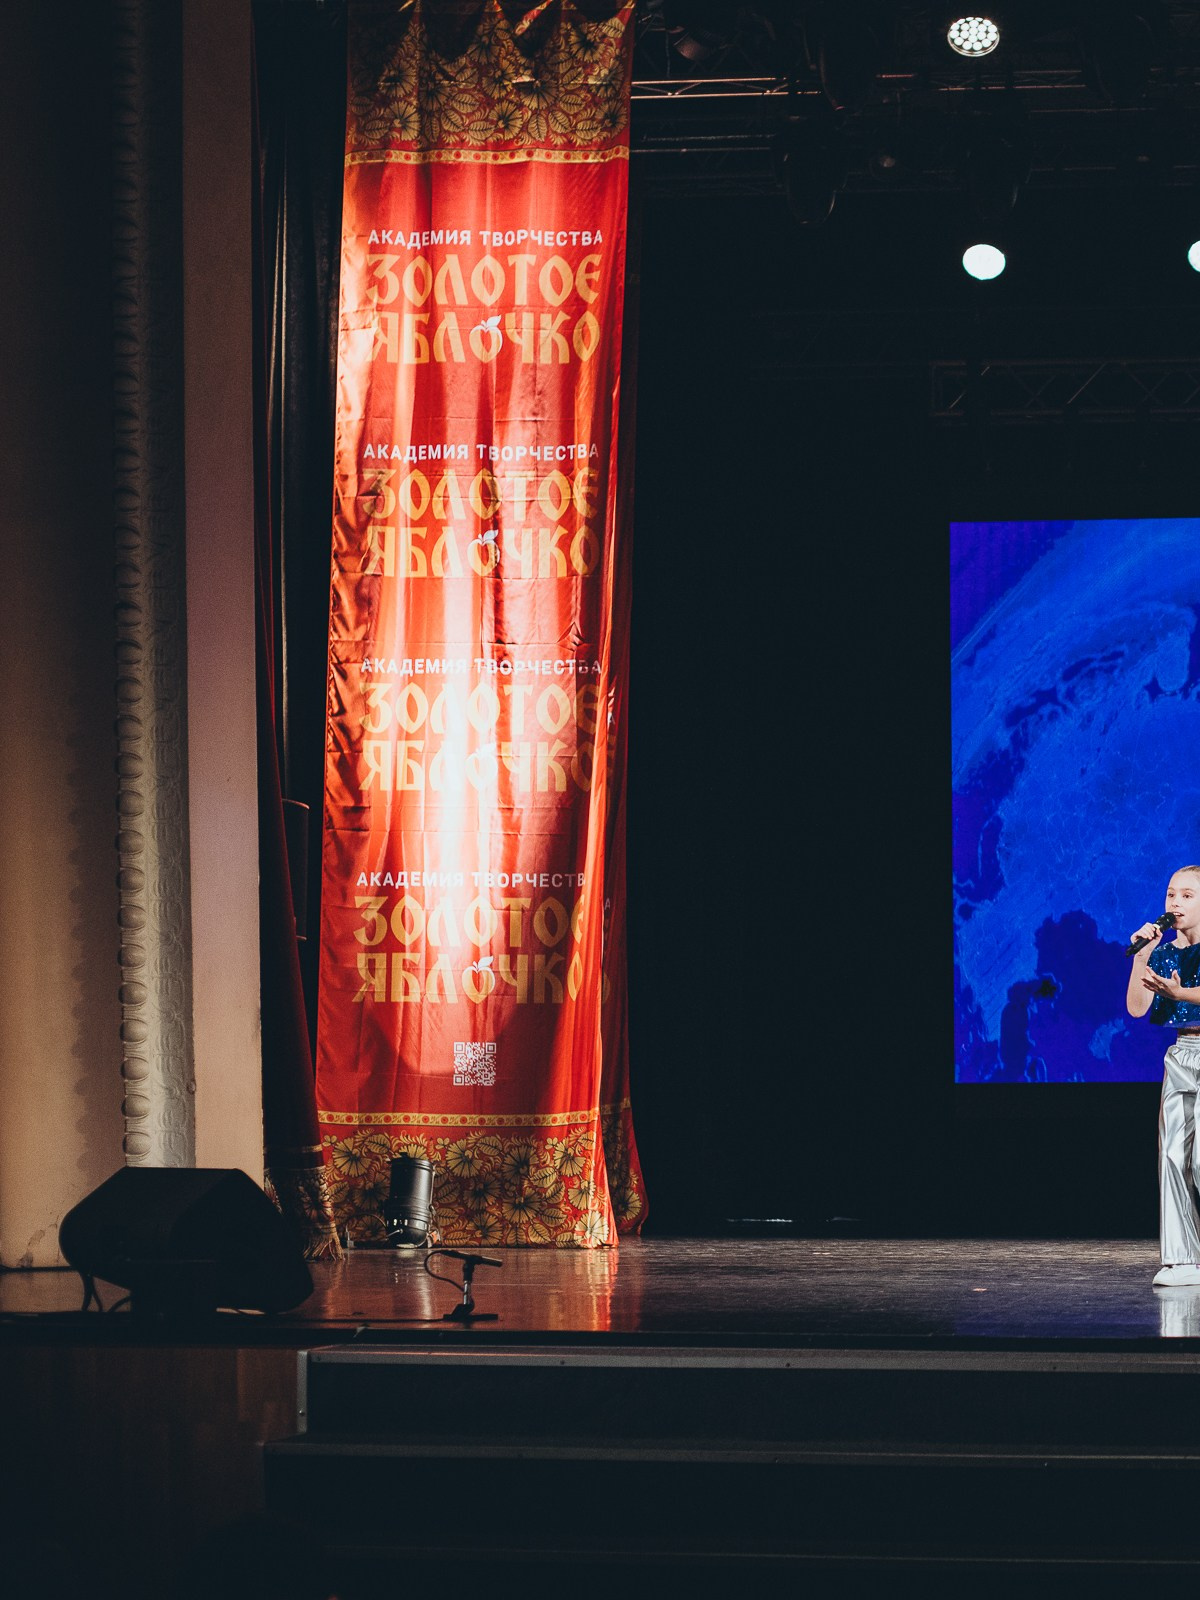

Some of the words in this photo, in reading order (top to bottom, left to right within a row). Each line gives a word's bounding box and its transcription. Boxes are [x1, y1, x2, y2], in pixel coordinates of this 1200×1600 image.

[368, 229, 471, 249] АКАДЕМИЯ
[479, 229, 603, 247] ТВОРЧЕСТВА
[366, 254, 602, 308] ЗОЛОТОЕ
[366, 312, 601, 364] ЯБЛОЧКО
[363, 443, 468, 463] АКАДЕМИЯ
[476, 443, 599, 461] ТВОРЧЕСТВА
[363, 468, 600, 522] ЗОЛОТОЕ
[363, 525, 600, 578] ЯБЛОЧКО
[361, 658, 468, 677] АКАДЕМИЯ
[474, 658, 602, 676] ТВОРЧЕСТВА
[359, 682, 600, 735] ЗОЛОТОЕ
[358, 739, 594, 792] ЯБЛОЧКО
[357, 870, 464, 889] АКАДЕМИЯ
[352, 952, 583, 1004] ЯБЛОЧКО
